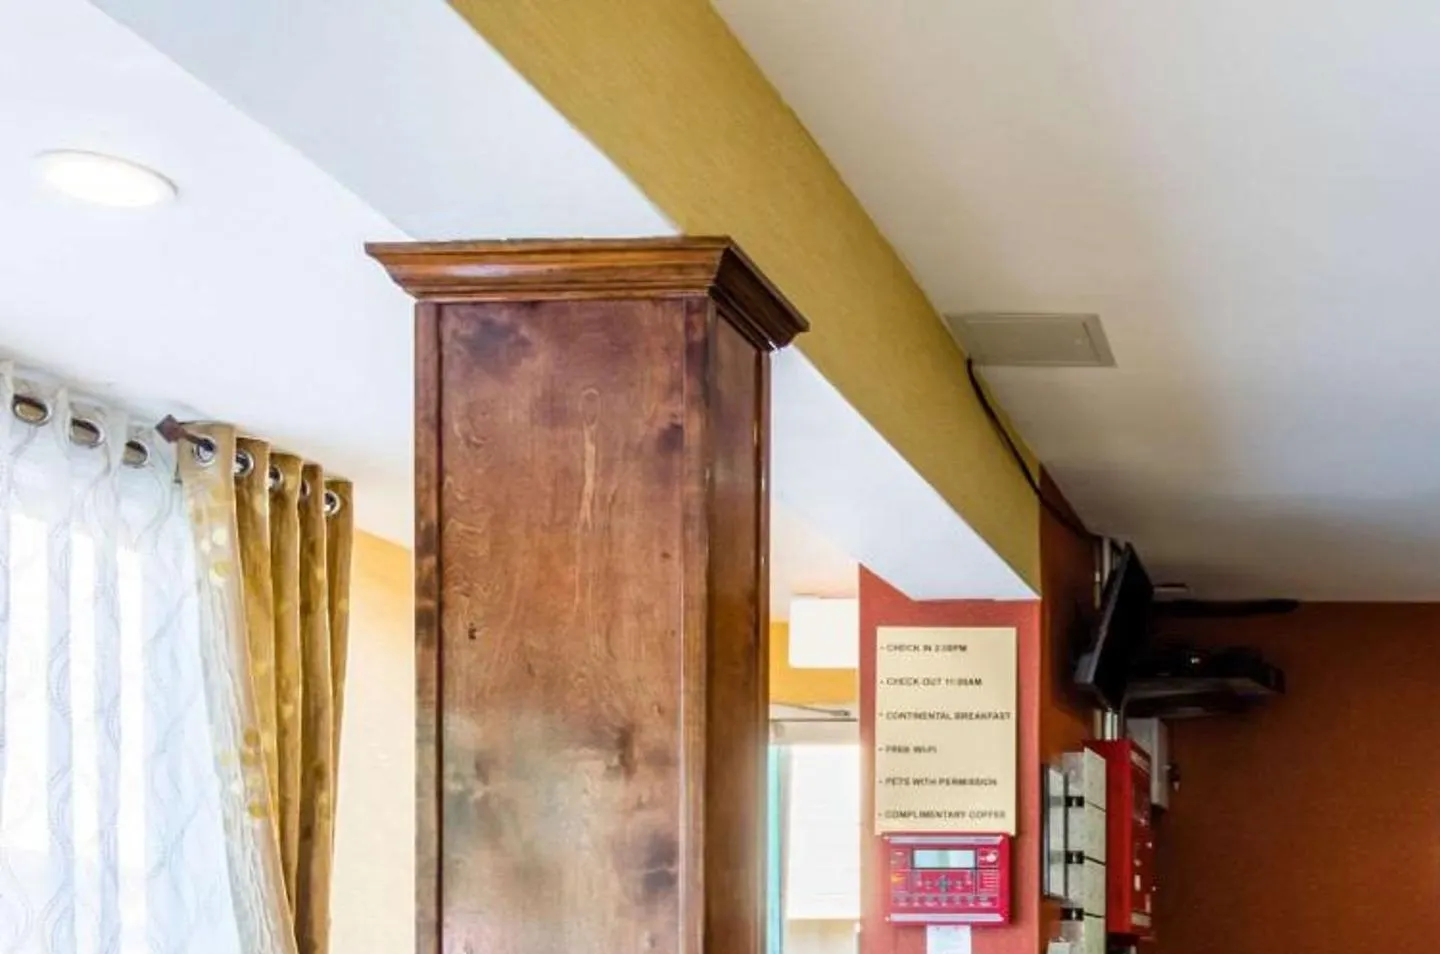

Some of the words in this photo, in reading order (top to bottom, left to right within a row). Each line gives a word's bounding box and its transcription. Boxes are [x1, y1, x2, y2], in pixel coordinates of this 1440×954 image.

[886, 643, 920, 653] CHECK
[923, 643, 933, 653] IN
[886, 676, 918, 686] CHECK
[922, 676, 942, 686] OUT
[886, 711, 952, 721] CONTINENTAL
[954, 711, 1011, 721] BREAKFAST
[885, 744, 911, 754] FREE
[885, 777, 910, 786] PETS
[912, 777, 937, 786] WITH
[938, 777, 998, 786] PERMISSION
[968, 809, 1006, 819] COFFEE
